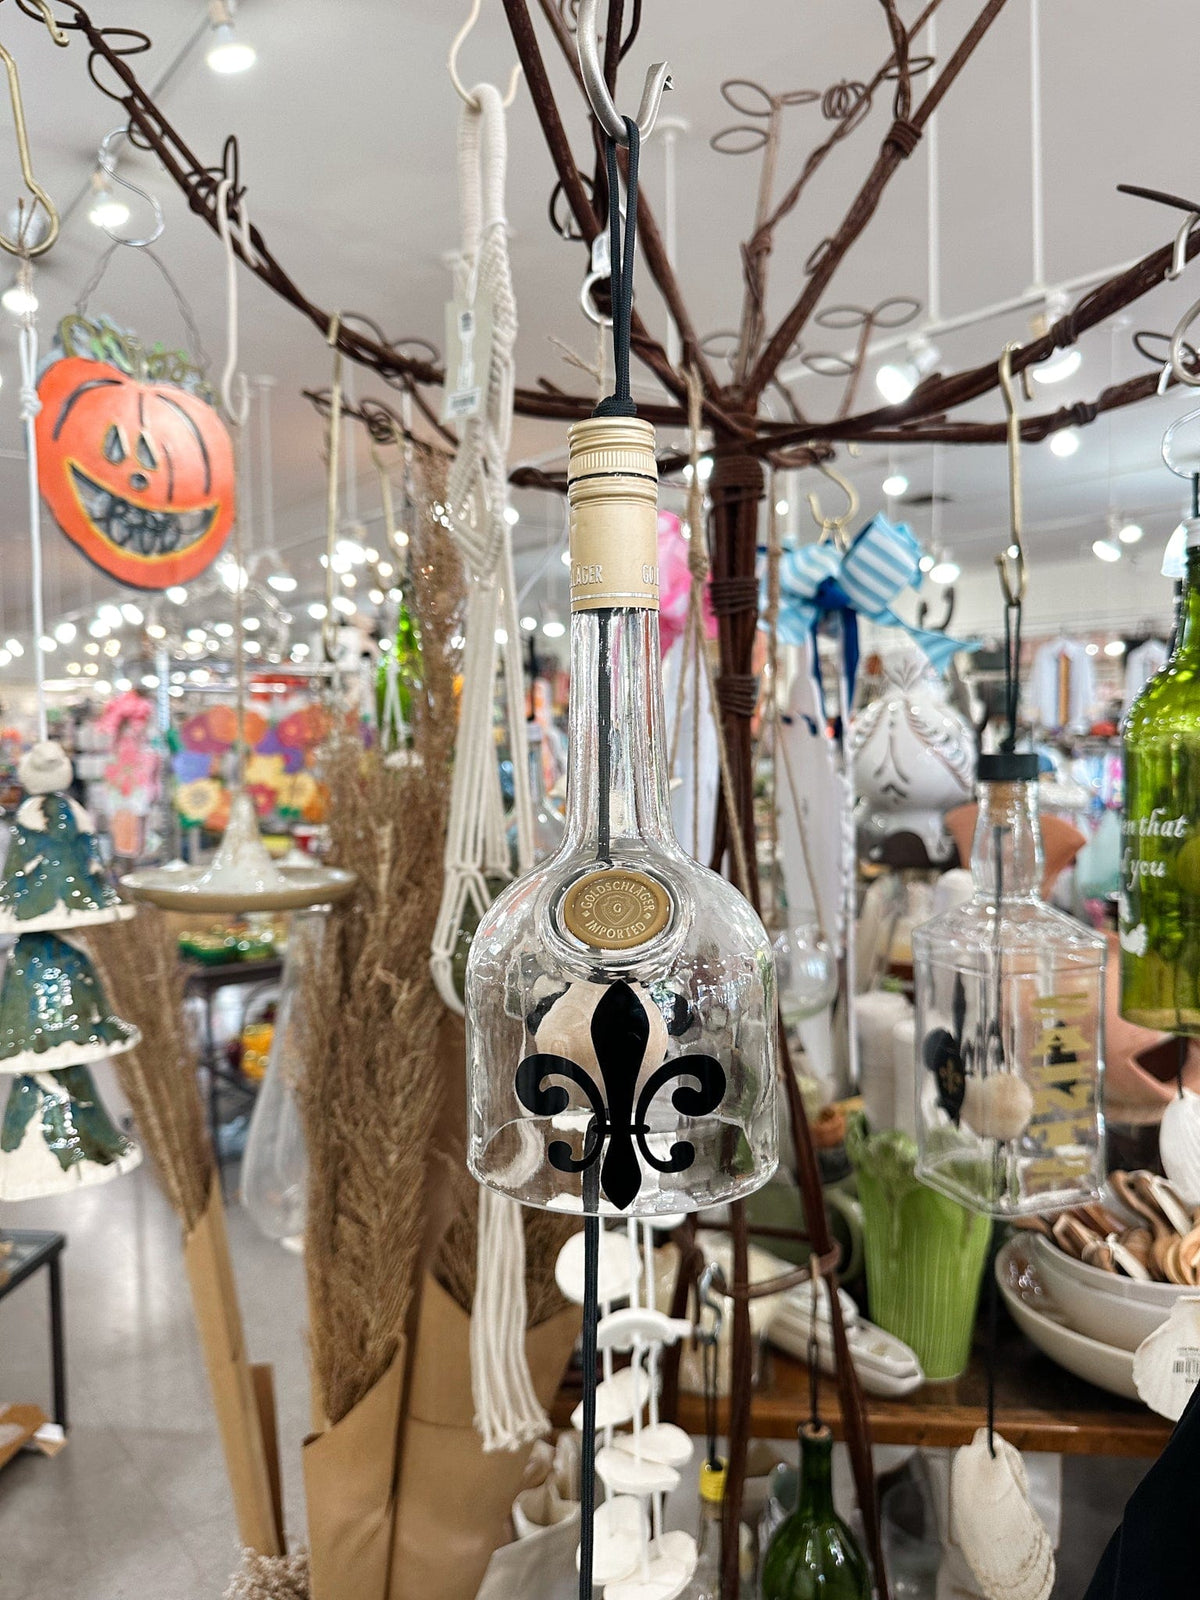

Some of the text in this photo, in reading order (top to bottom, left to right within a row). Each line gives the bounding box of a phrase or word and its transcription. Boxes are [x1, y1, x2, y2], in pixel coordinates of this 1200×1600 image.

[1139, 807, 1188, 837] that
[1127, 860, 1166, 891] you
[581, 881, 655, 912] GOLDSCHLÄGER
[585, 920, 646, 939] IMPORTED
